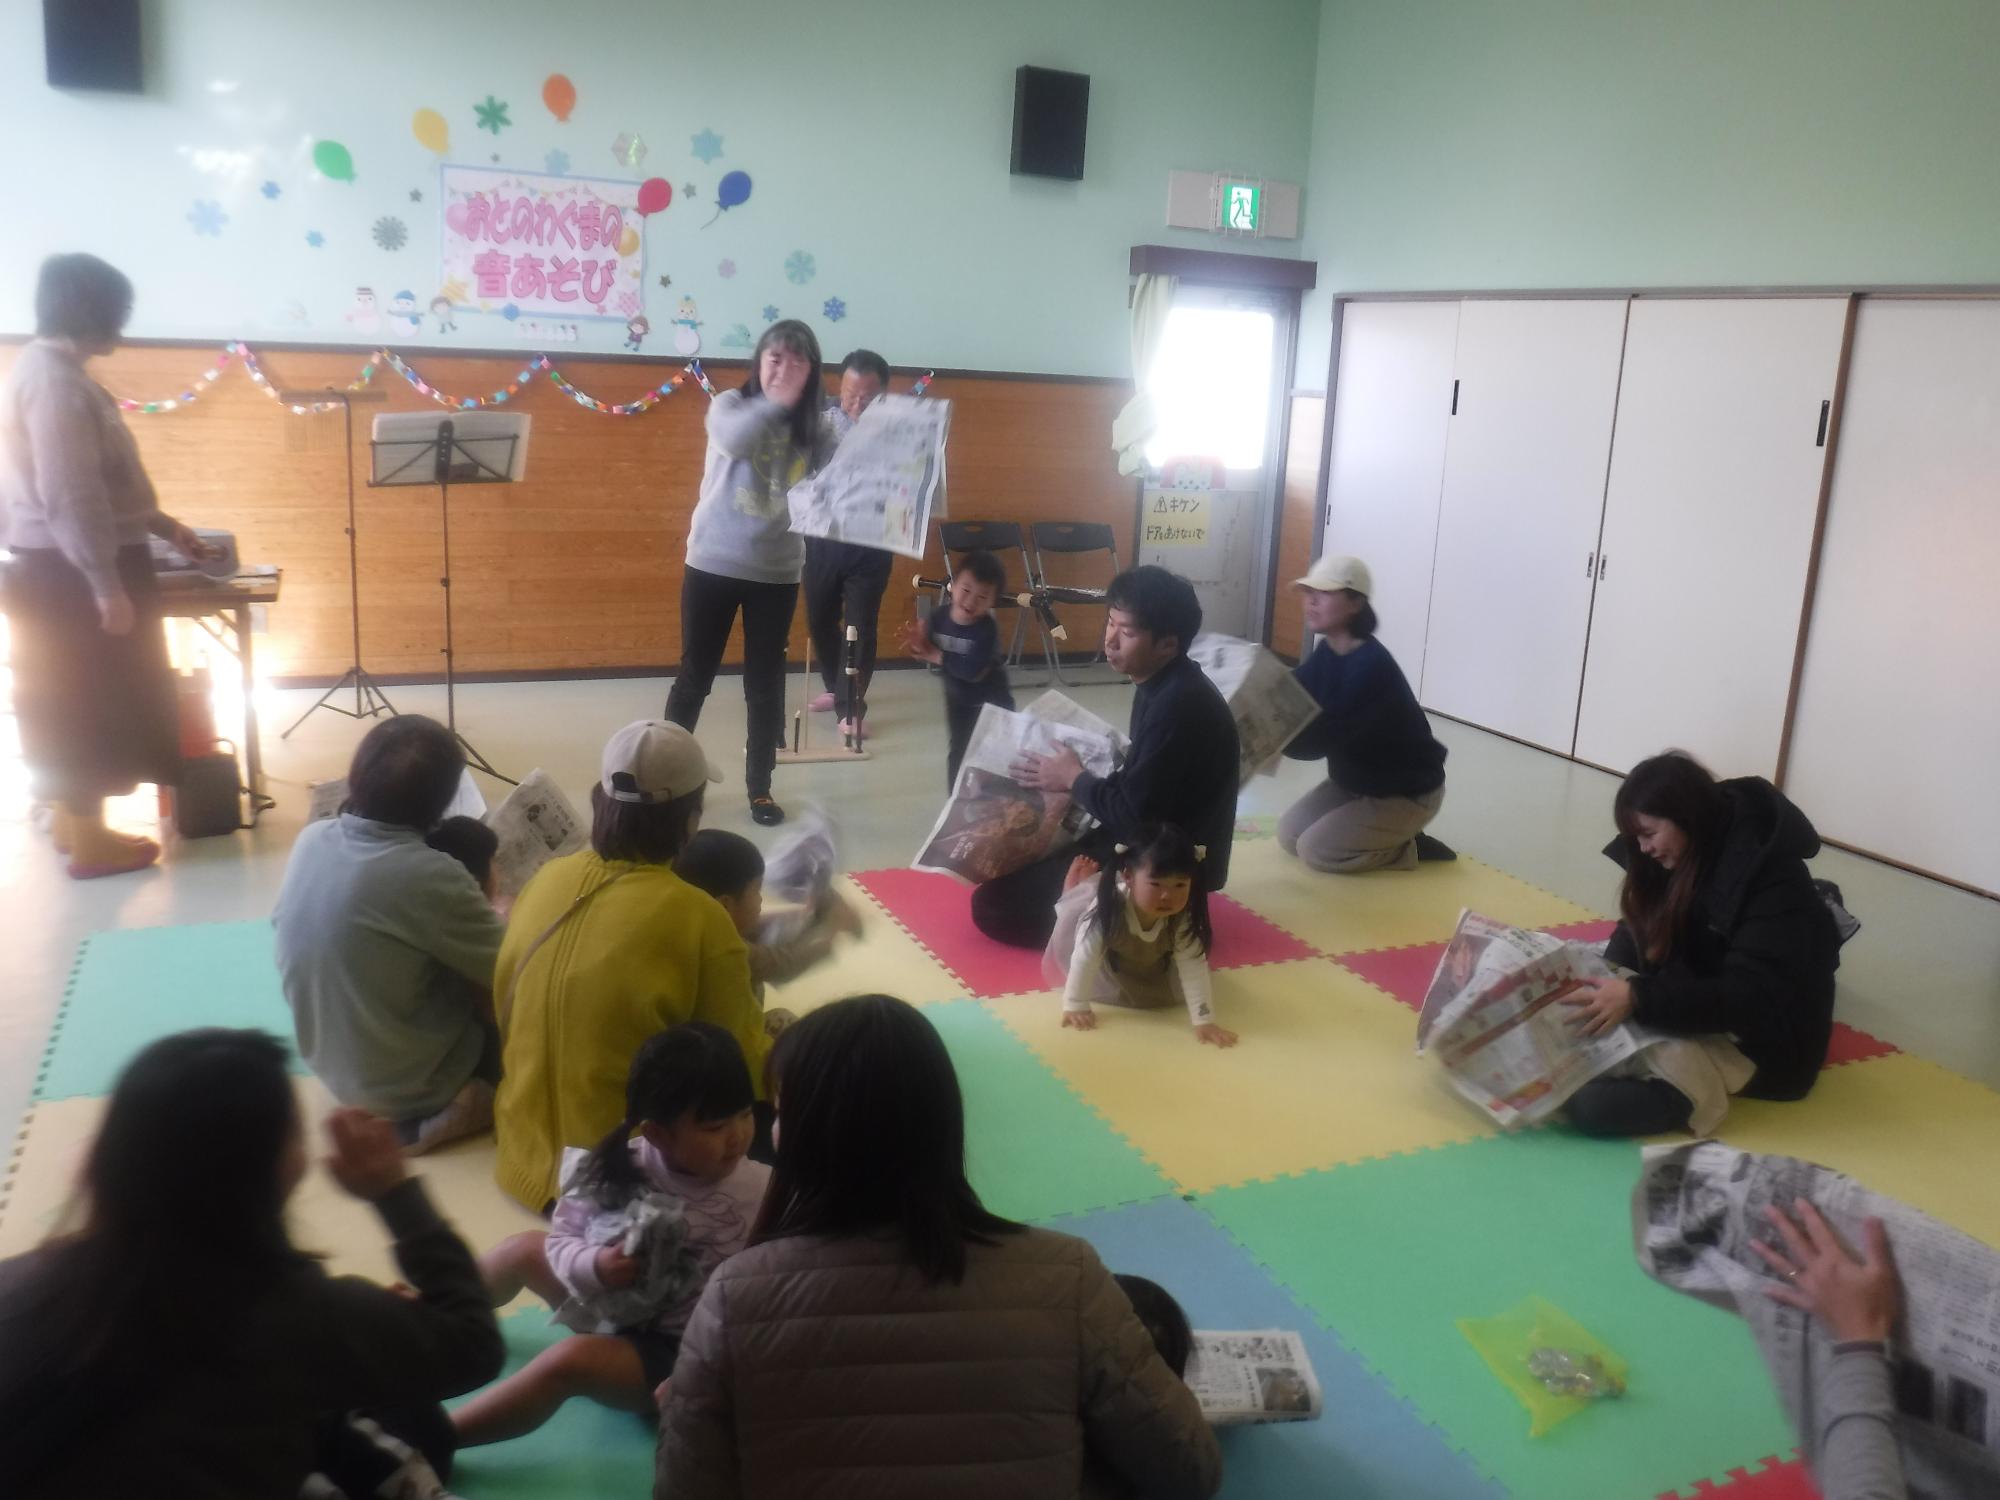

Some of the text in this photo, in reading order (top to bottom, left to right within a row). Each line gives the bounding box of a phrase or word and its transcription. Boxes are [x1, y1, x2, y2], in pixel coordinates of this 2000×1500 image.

[473, 251, 617, 304] 音あそび
[1170, 497, 1200, 513] キケン
